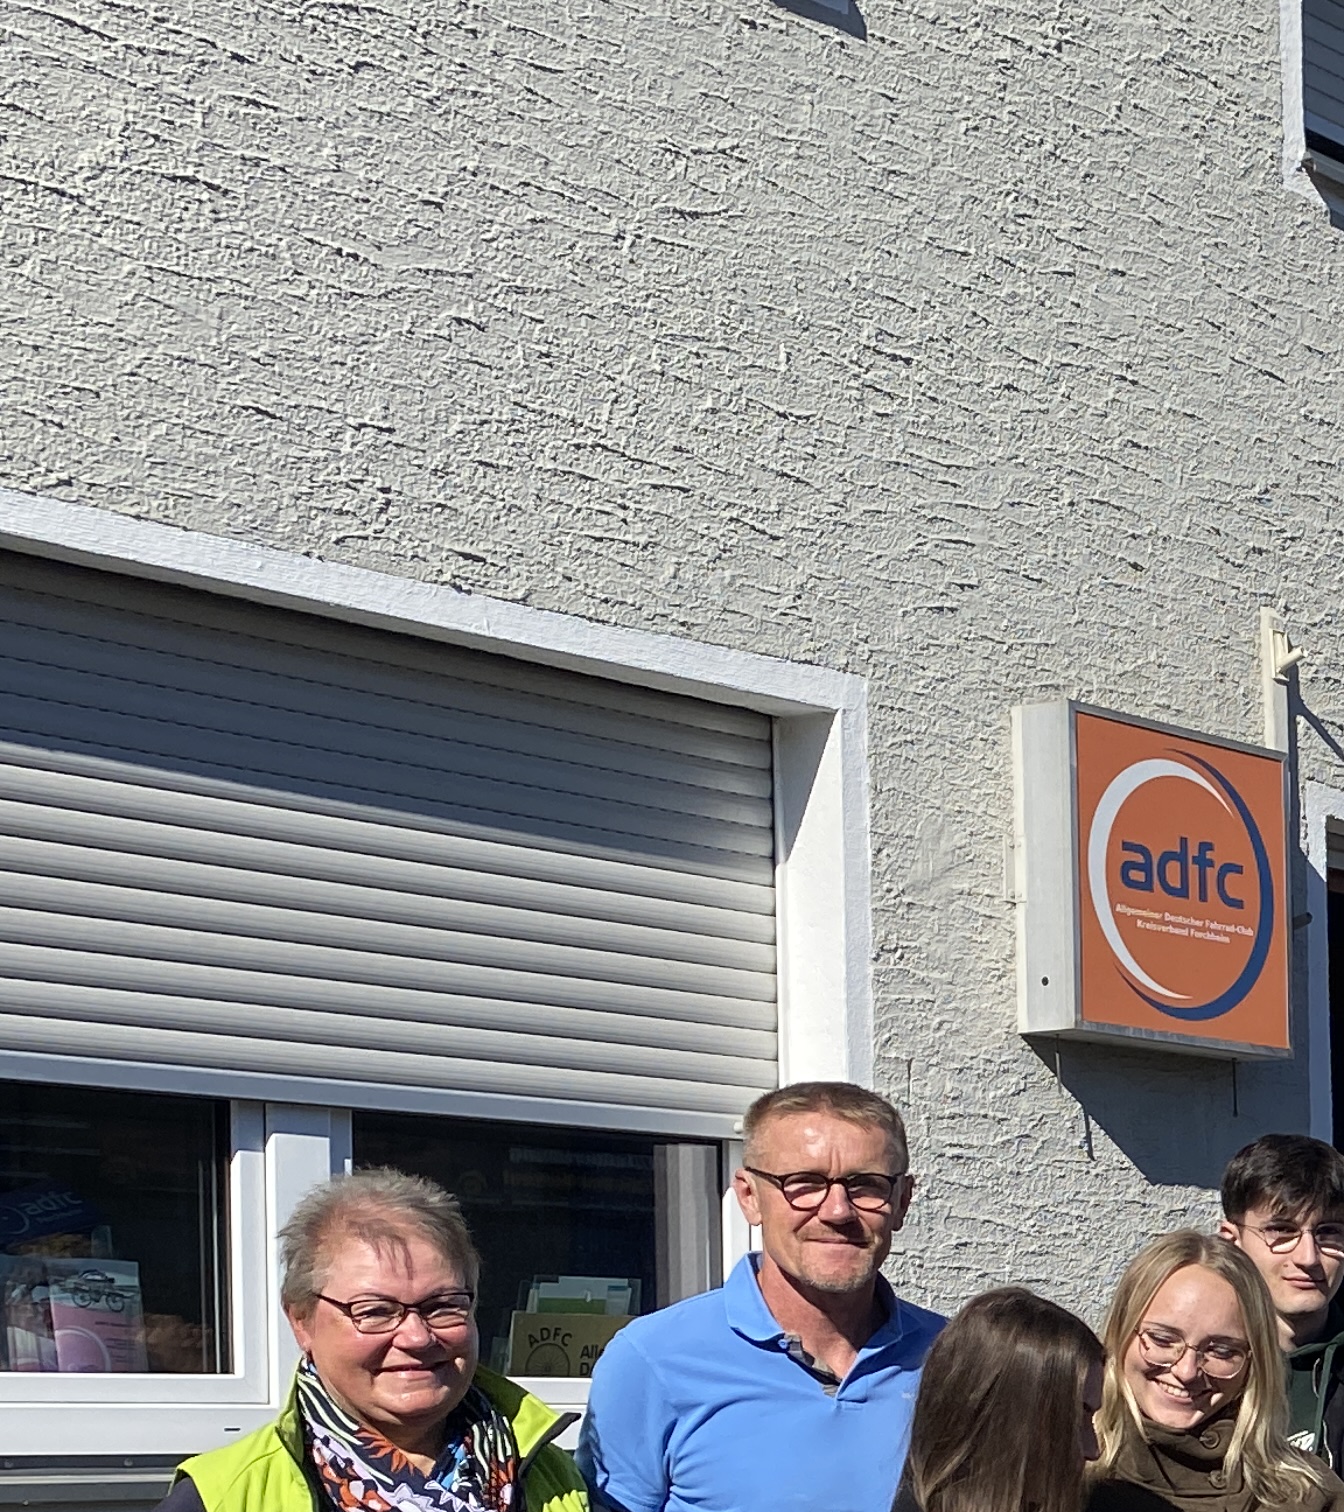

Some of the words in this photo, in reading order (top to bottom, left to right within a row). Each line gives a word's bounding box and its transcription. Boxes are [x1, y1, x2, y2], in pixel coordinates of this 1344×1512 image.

[1120, 836, 1244, 909] adfc
[1164, 912, 1204, 927] Deutscher
[527, 1326, 573, 1348] ADFC
